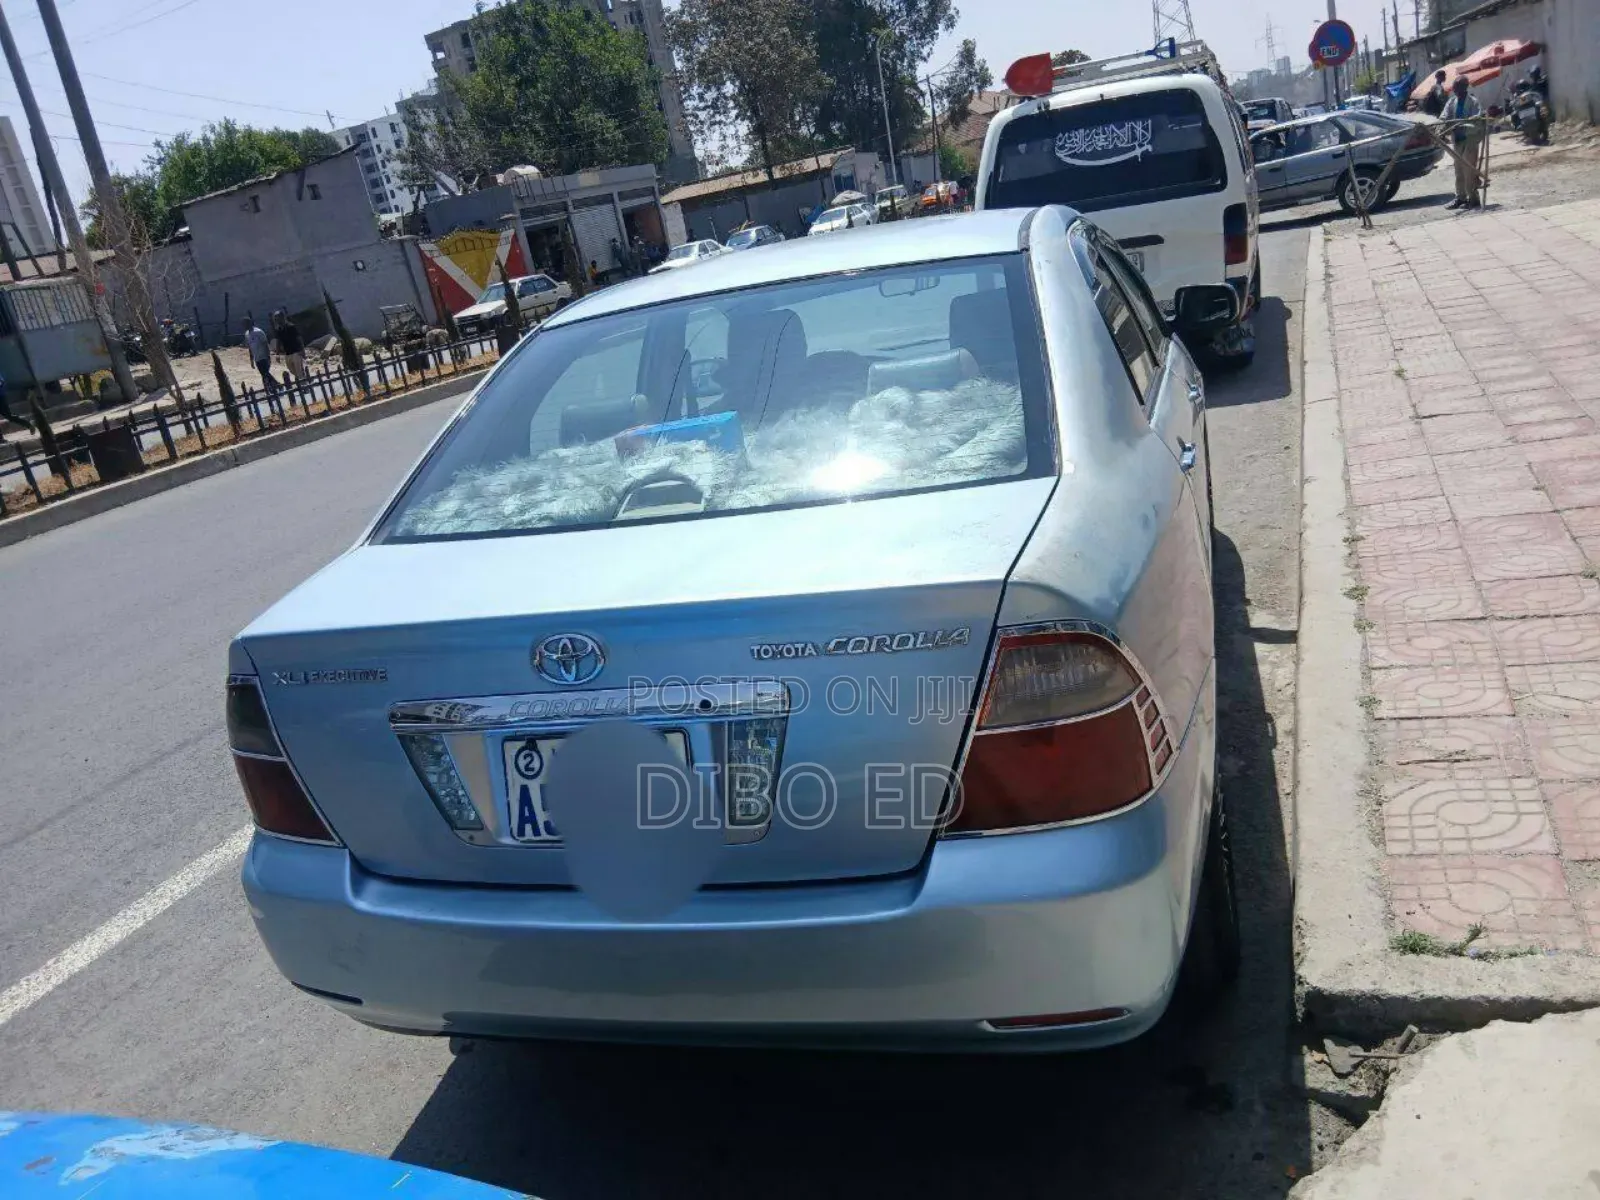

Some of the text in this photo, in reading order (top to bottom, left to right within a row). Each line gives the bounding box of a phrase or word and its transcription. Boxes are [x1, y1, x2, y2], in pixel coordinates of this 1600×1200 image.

[750, 627, 970, 660] TOYOTA COROLLA
[310, 667, 388, 683] EXECUTIVE
